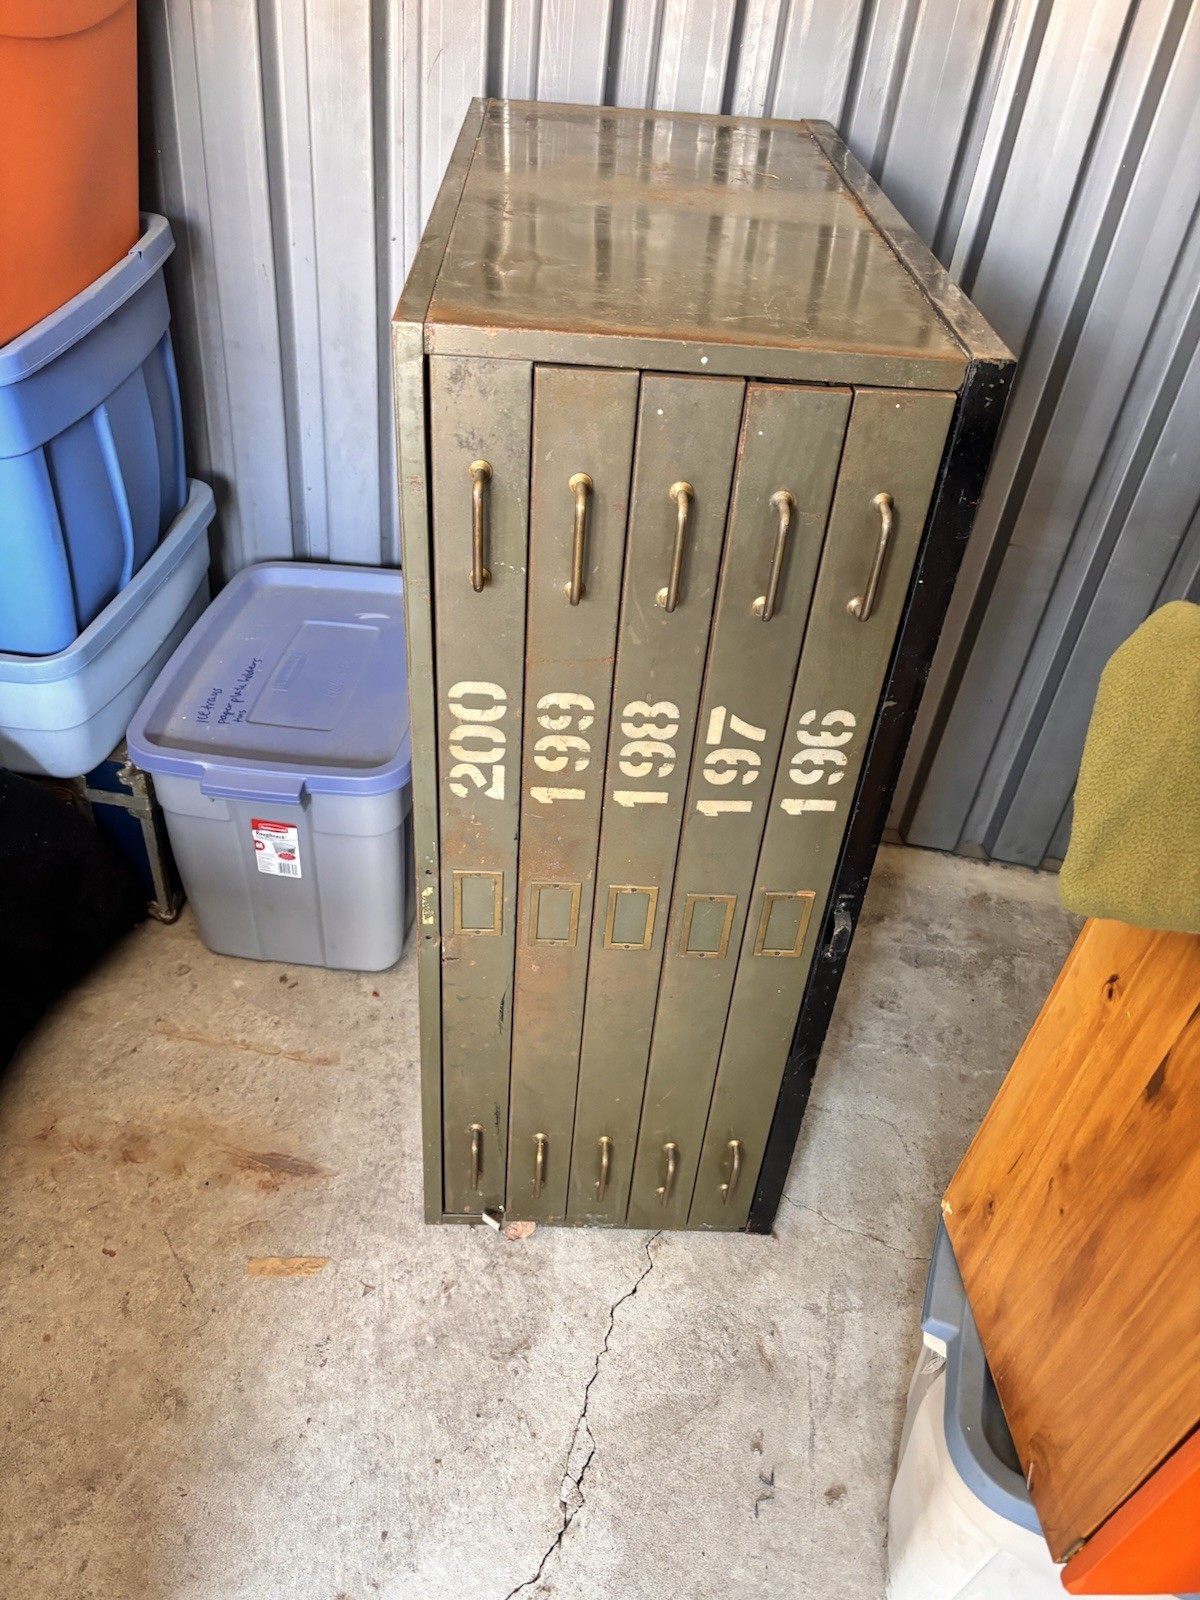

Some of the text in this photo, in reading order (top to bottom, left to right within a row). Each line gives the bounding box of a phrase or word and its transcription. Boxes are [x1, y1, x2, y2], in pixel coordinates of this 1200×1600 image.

[218, 703, 235, 724] paper
[447, 681, 508, 801] 200
[530, 692, 595, 804] 199
[613, 700, 681, 807] 198
[696, 705, 767, 816] 197
[780, 709, 857, 815] 196
